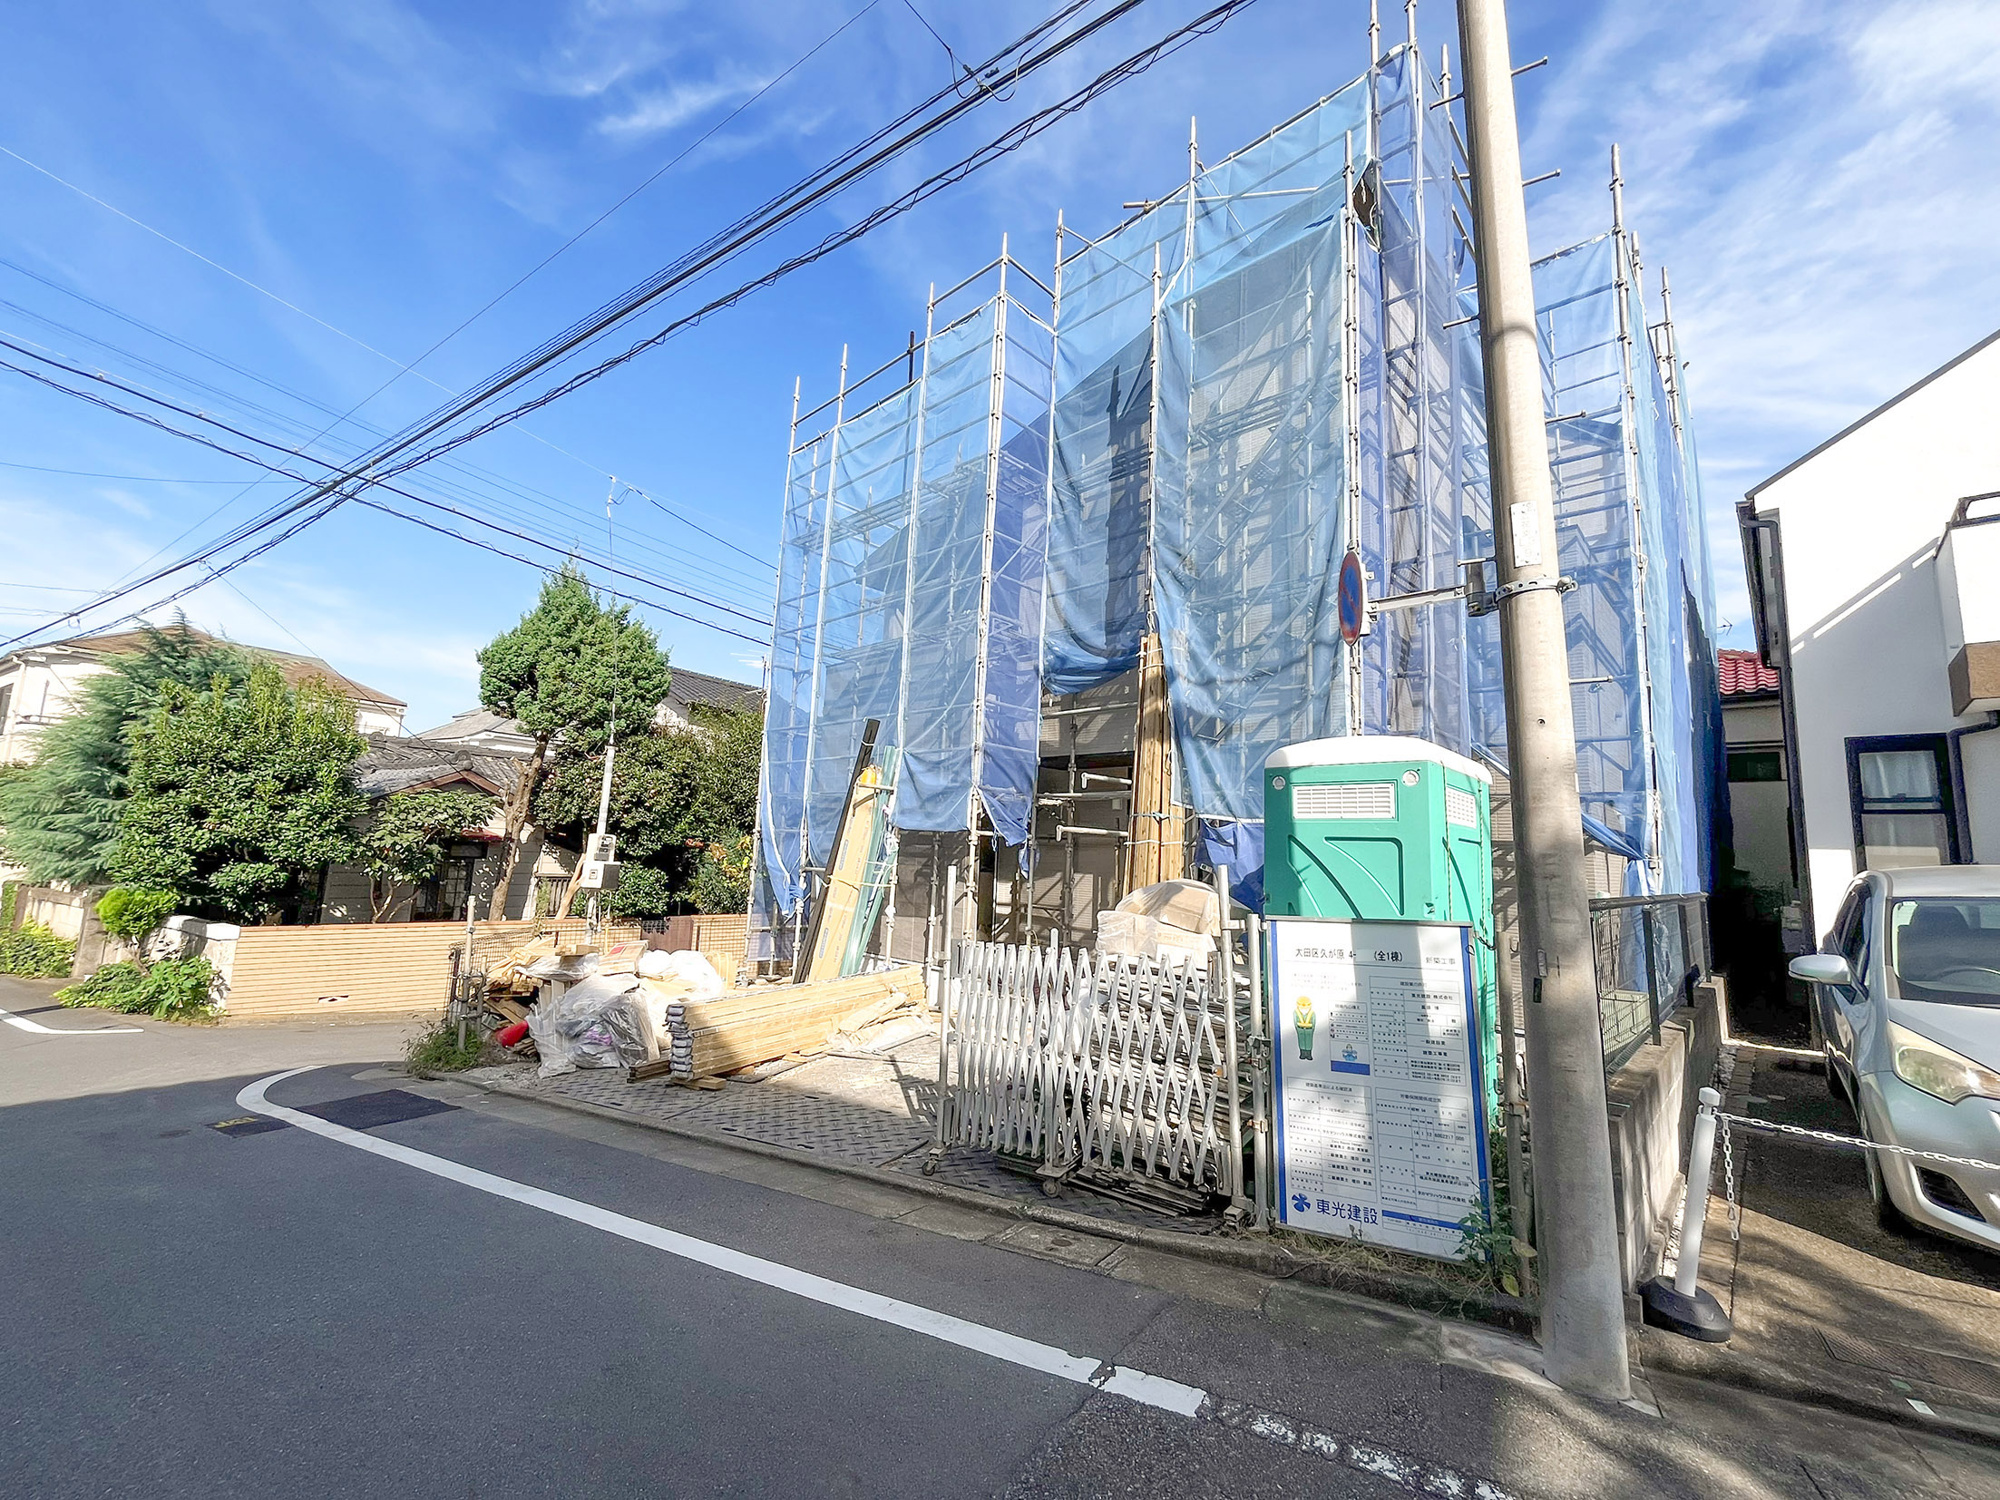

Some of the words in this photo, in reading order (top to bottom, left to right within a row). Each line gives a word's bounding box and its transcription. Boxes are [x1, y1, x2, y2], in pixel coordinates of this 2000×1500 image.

[1295, 948, 1345, 960] 大田区久が原
[1425, 956, 1456, 965] 新築工事
[1316, 1198, 1379, 1225] 東光建設
